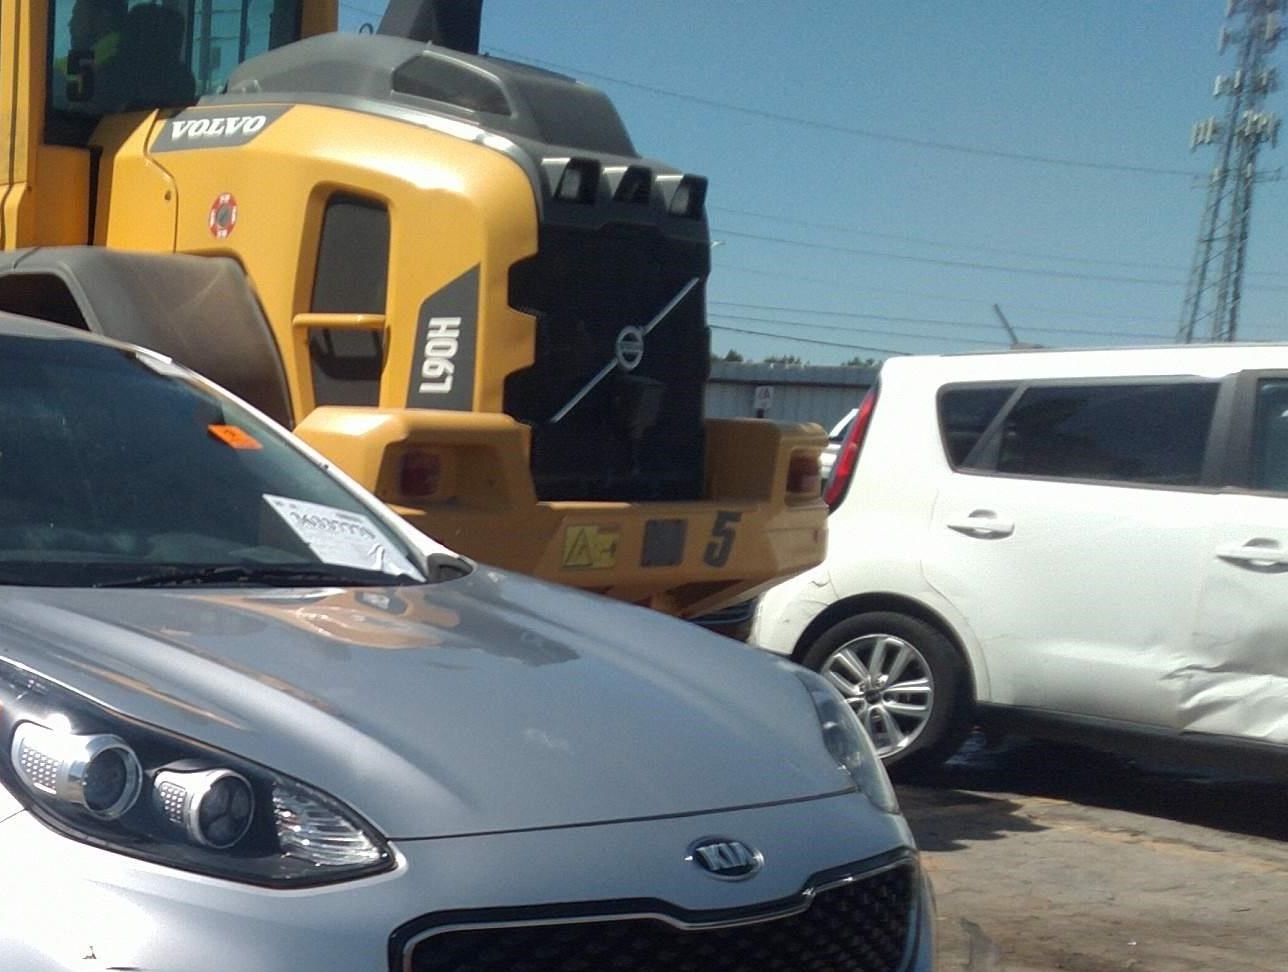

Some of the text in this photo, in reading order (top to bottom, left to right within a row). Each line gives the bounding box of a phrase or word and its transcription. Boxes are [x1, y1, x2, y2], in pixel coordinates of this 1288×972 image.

[171, 115, 266, 140] VOLVO
[418, 316, 462, 394] L90H
[703, 510, 744, 568] 5
[693, 840, 755, 873] KIA
